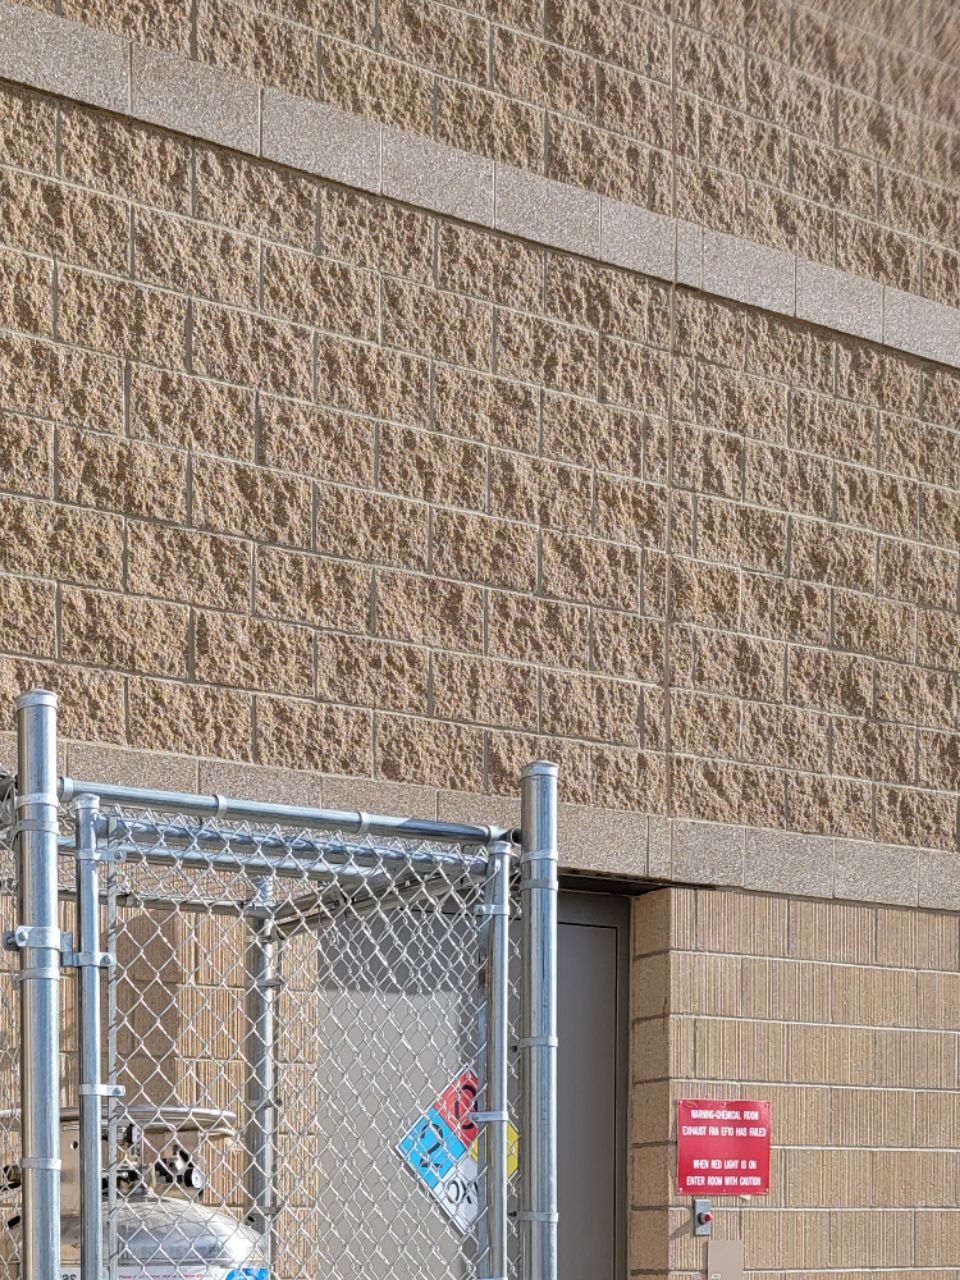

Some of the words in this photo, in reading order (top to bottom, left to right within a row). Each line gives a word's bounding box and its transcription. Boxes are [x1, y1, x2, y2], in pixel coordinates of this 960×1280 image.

[691, 1110, 741, 1120] WARNING-CHEMICAL
[744, 1111, 759, 1120] ROOM
[682, 1126, 706, 1136] EXHAUST
[709, 1127, 718, 1136] FAN
[736, 1127, 747, 1136] HAS
[749, 1127, 766, 1137] FAILED
[419, 1124, 444, 1168] 2
[693, 1160, 709, 1169] WHEN
[711, 1160, 722, 1169] RED
[724, 1160, 739, 1169] LIGHT
[741, 1160, 746, 1169] IS
[749, 1160, 756, 1169] ON
[686, 1176, 705, 1185] ENTER
[707, 1176, 722, 1186] ROOM
[725, 1176, 737, 1186] WITH
[740, 1176, 761, 1186] CAUTION
